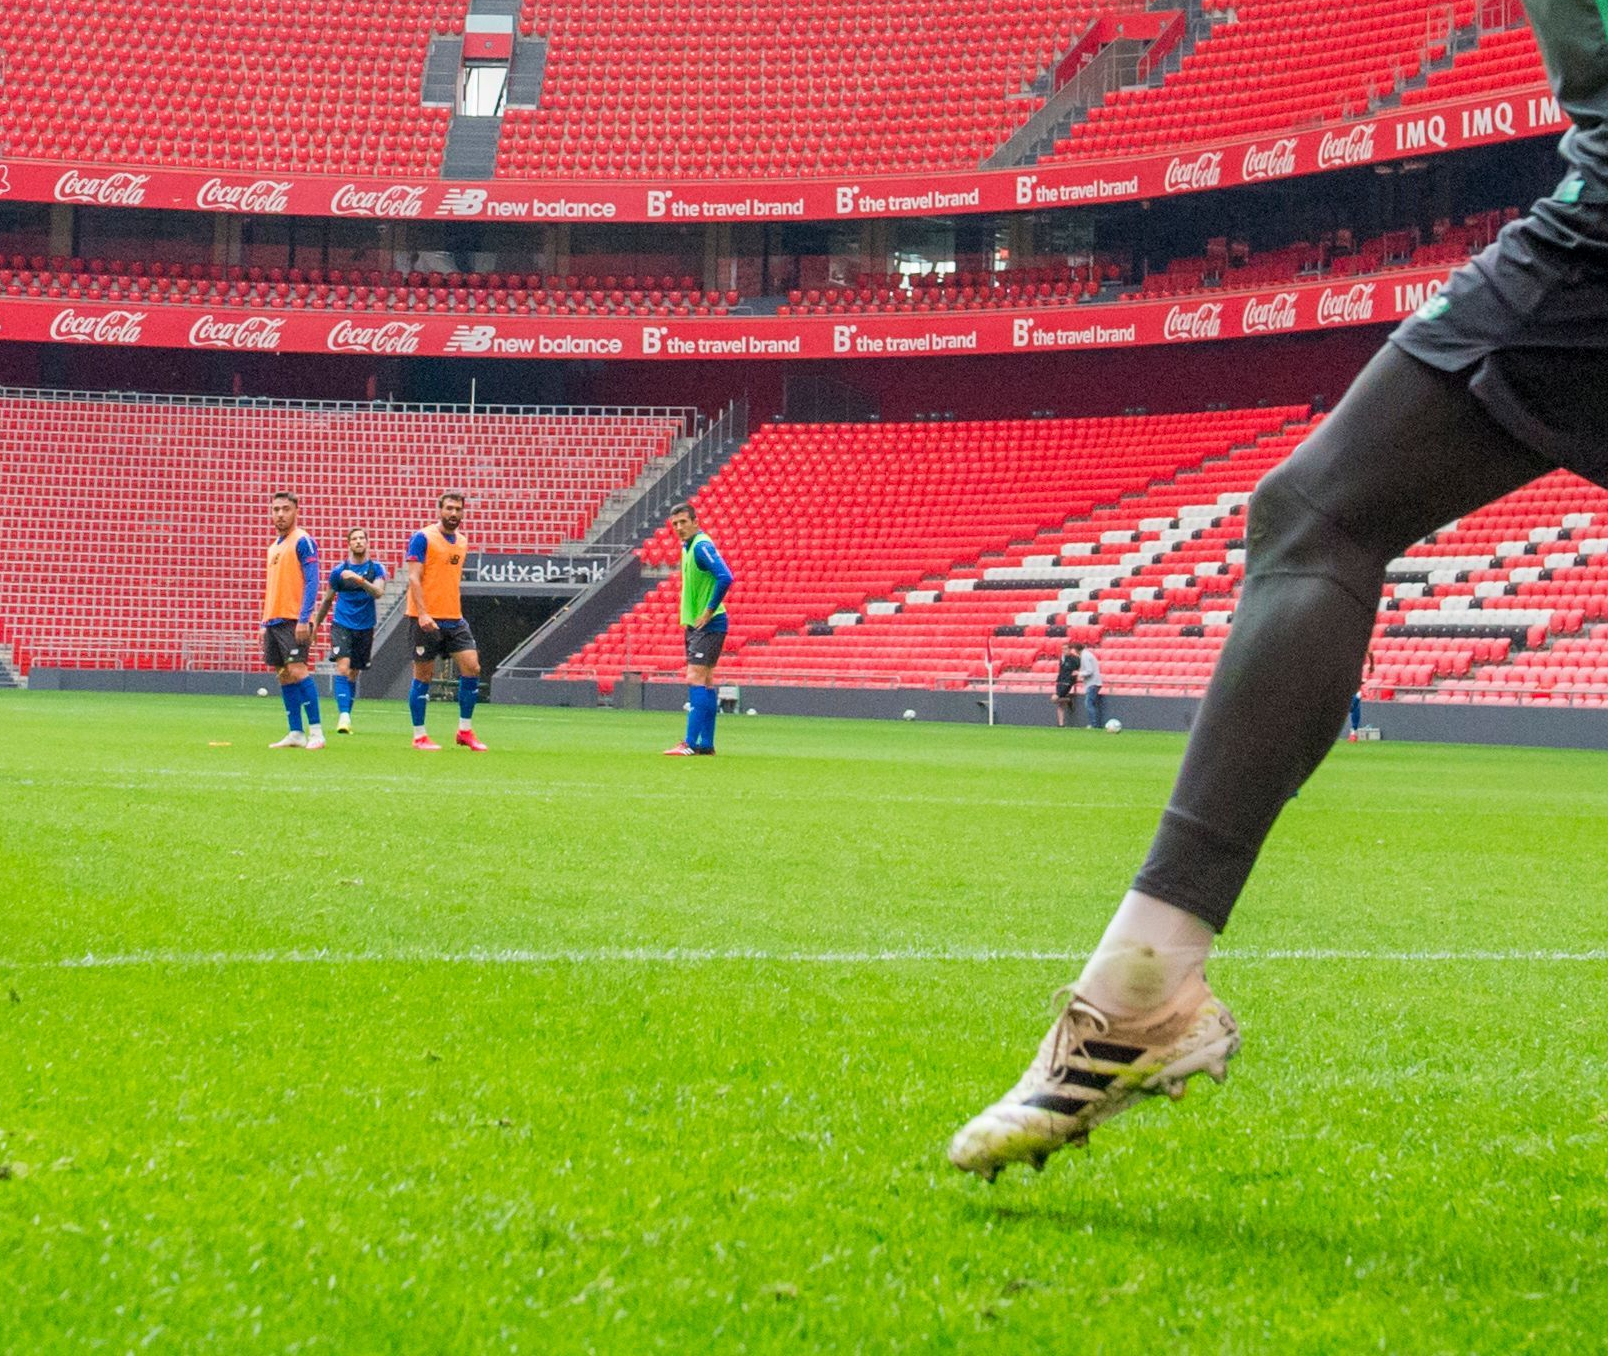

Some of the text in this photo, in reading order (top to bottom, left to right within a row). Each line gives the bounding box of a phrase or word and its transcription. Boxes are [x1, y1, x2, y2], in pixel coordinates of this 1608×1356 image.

[1462, 103, 1515, 137] IMQ
[1397, 116, 1447, 149] IMQ
[1036, 186, 1058, 202] the
[1060, 181, 1097, 200] travel
[1100, 177, 1137, 196] brand
[488, 202, 528, 216] new
[533, 199, 616, 217] balance
[673, 201, 699, 216] the
[703, 200, 750, 216] travel
[755, 199, 803, 215] brand
[860, 196, 885, 212] the
[890, 192, 932, 210] travel
[935, 188, 978, 207] brand
[494, 339, 535, 352] new
[540, 335, 622, 353] balance
[856, 336, 883, 351] the
[886, 334, 928, 351] travel
[933, 332, 976, 349] brand
[1033, 329, 1054, 345] the
[1058, 327, 1094, 344] travel
[1097, 325, 1134, 342] brand
[668, 337, 695, 353] the
[698, 337, 746, 353] travel
[750, 337, 799, 352] brand
